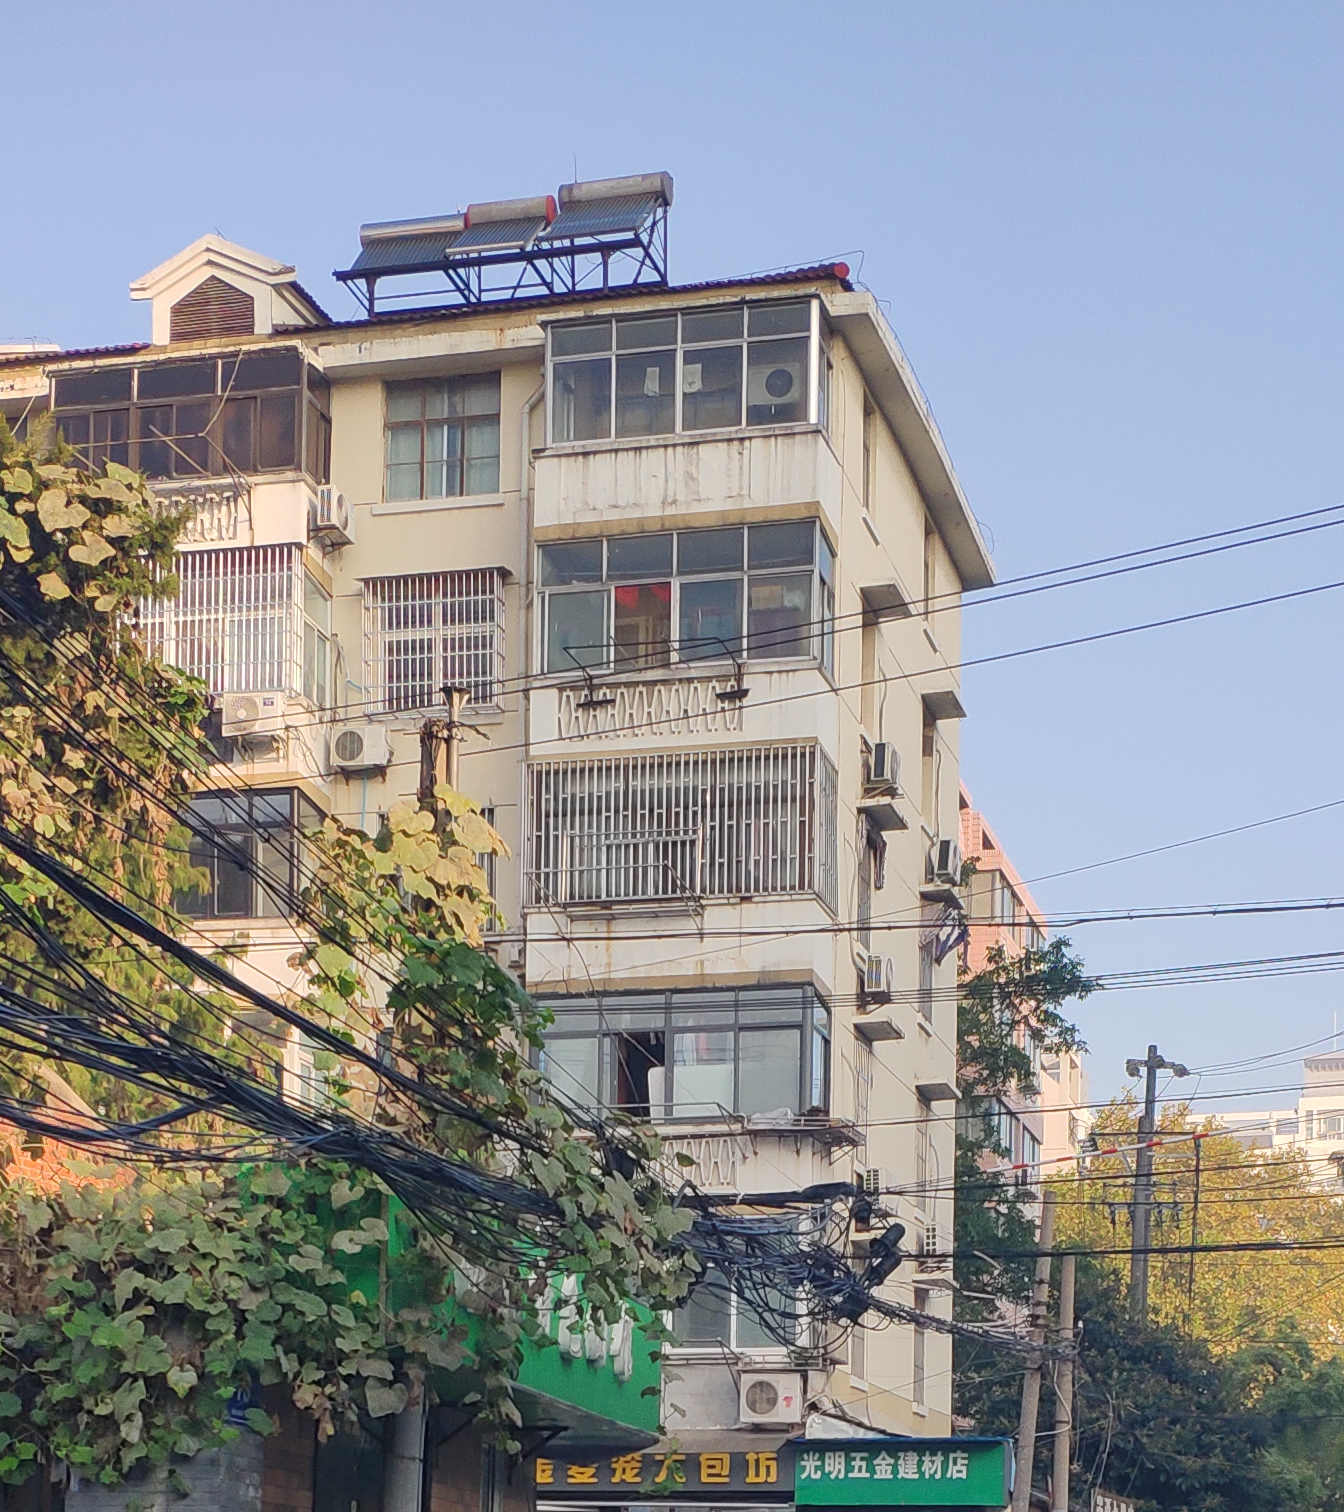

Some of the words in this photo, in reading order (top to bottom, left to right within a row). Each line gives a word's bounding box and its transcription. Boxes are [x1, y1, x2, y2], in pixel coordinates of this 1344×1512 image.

[800, 1450, 970, 1480] 光明五金建材店
